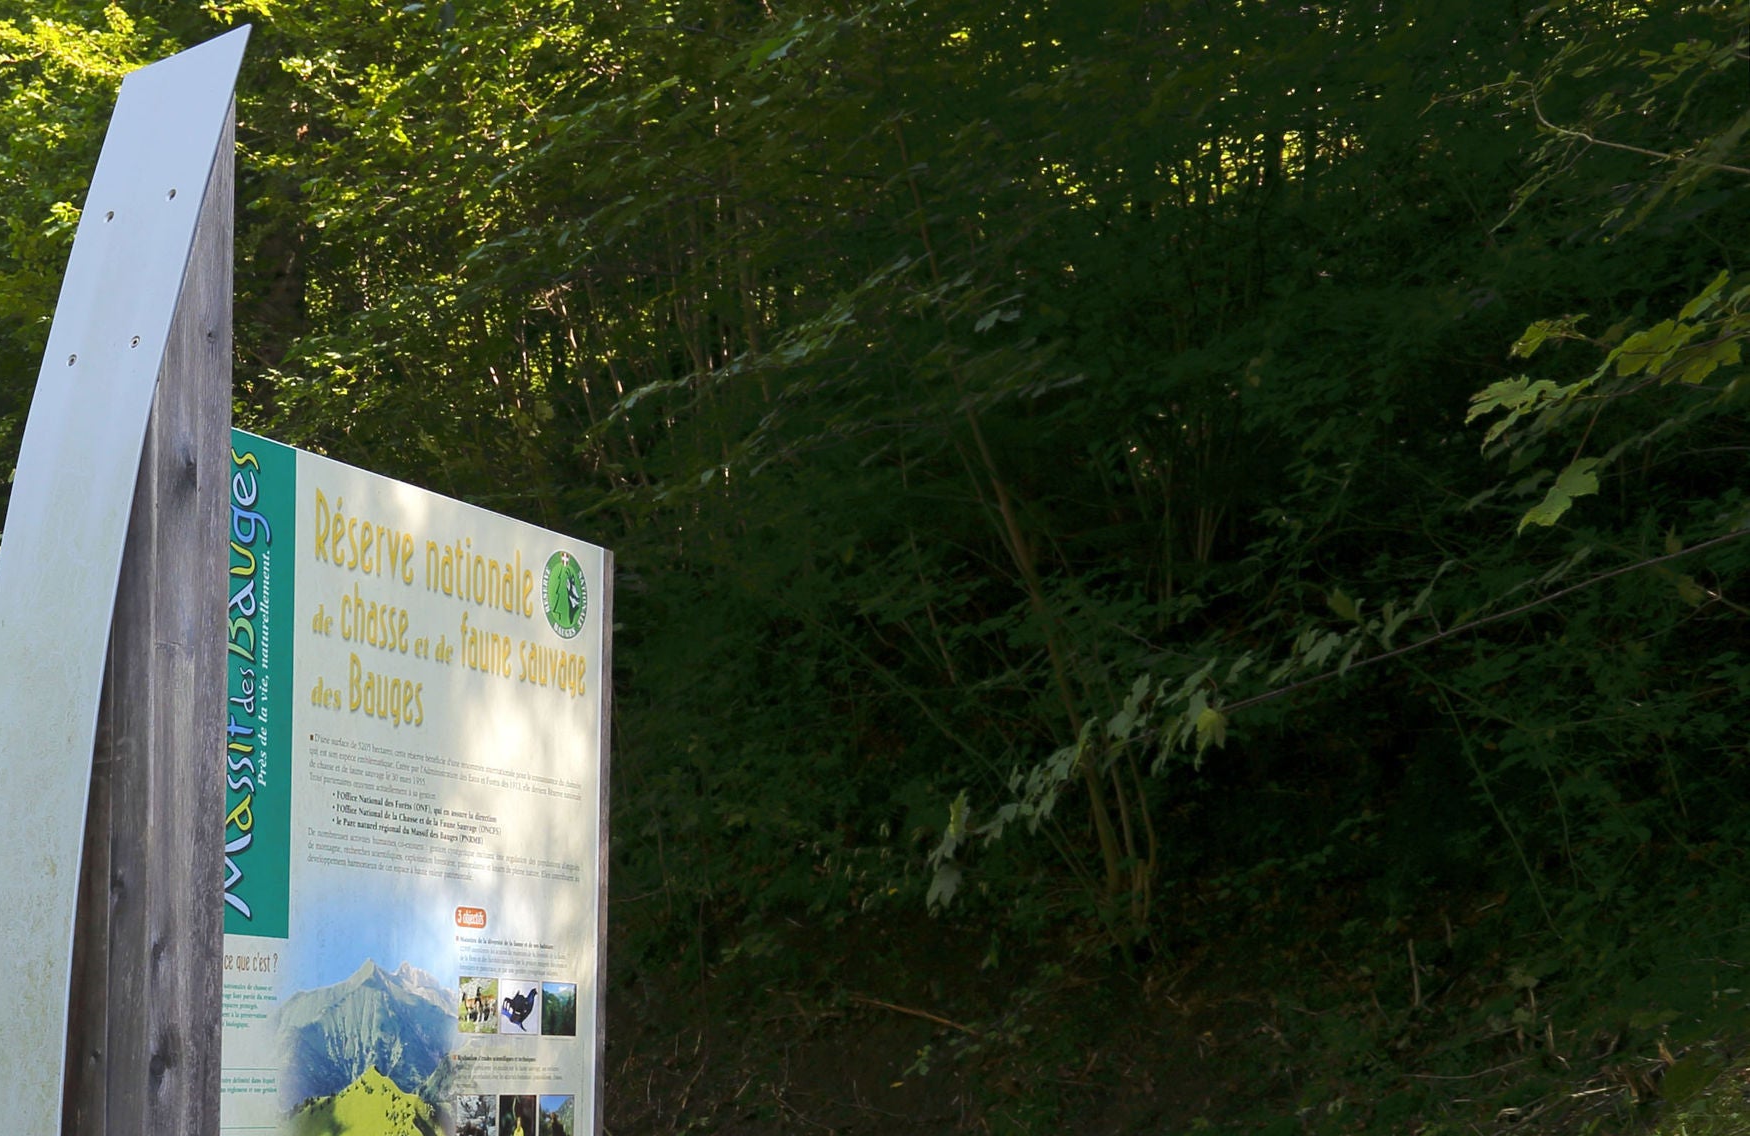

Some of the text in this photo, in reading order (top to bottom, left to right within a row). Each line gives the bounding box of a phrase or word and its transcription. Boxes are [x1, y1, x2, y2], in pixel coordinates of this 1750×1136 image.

[315, 487, 534, 618] Réserve nationale
[257, 550, 271, 787] Près de la vie, naturellement.
[312, 581, 586, 697] de chasse et de faune sauvage
[224, 447, 272, 918] Massif des Bauges
[311, 652, 424, 727] des Bauges
[359, 794, 383, 807] National
[359, 807, 383, 819] National
[457, 910, 485, 926] 3 objectifs
[236, 955, 250, 973] que
[252, 952, 271, 972] c'est
